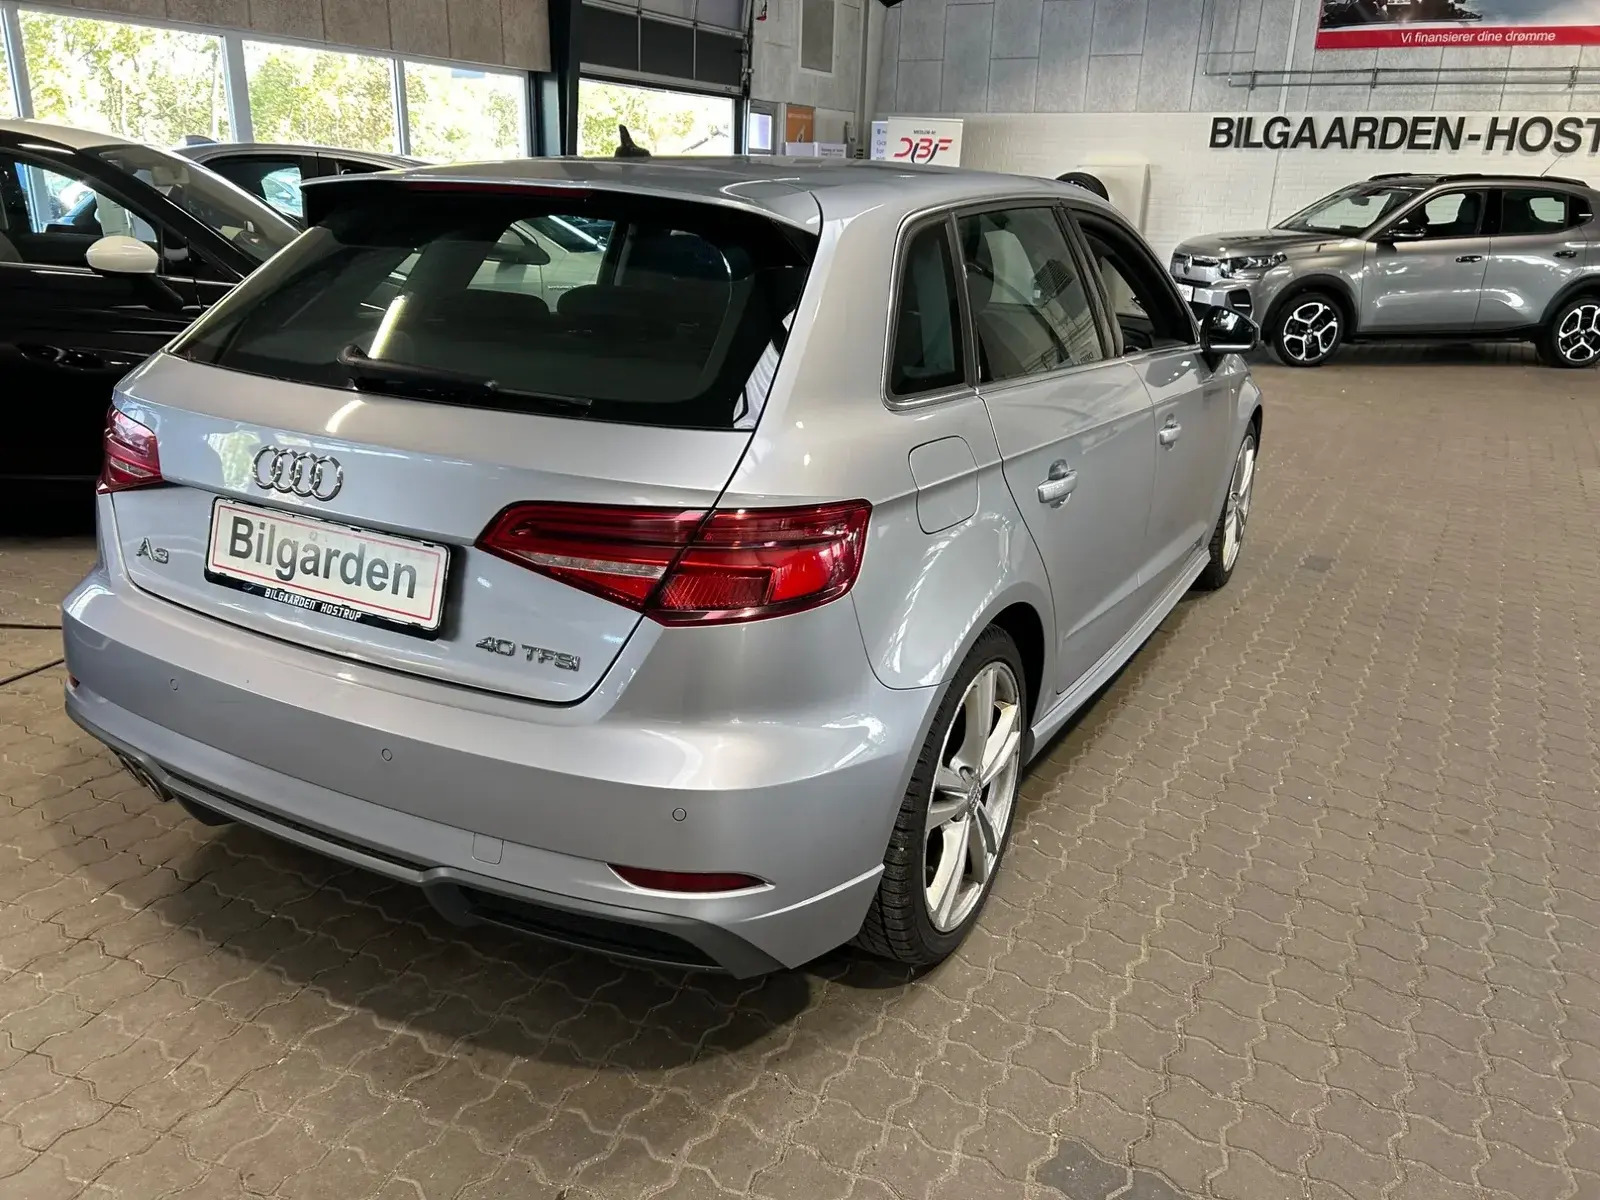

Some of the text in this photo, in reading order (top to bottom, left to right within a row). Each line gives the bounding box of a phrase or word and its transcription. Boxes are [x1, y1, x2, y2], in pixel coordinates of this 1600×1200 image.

[1401, 30, 1556, 43] Vi finansierer dine drømme
[136, 537, 169, 564] A3
[264, 588, 362, 621] BILGAARDEN HOSTRUP
[476, 636, 581, 672] 40 TFSI
